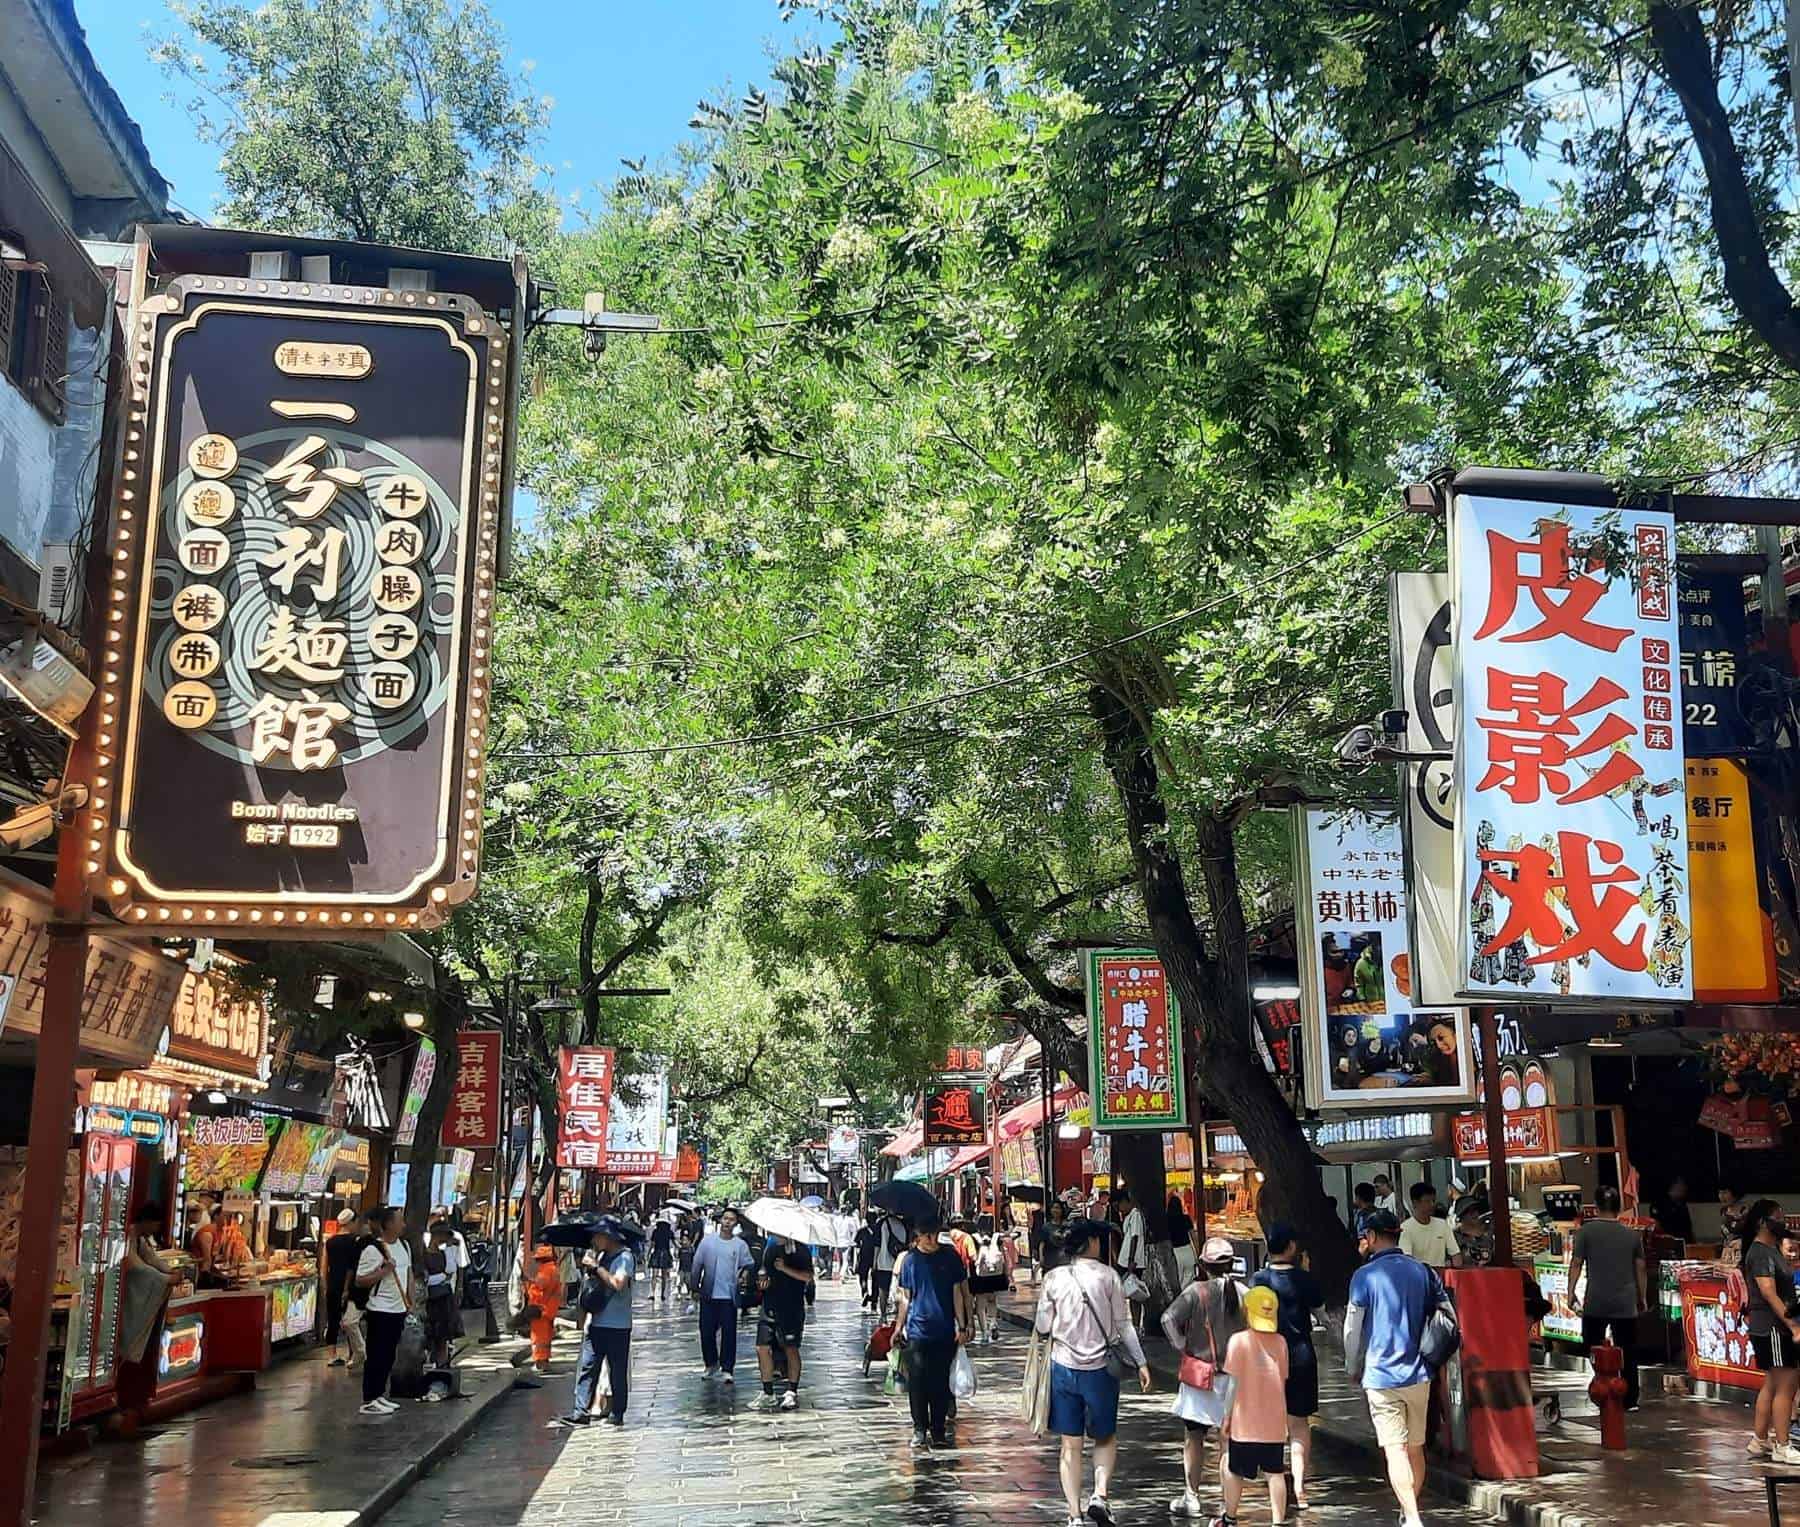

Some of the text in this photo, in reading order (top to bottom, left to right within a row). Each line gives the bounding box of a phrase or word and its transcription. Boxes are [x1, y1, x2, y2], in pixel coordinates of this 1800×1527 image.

[368, 481, 421, 702] 牛肉臊子面
[171, 592, 219, 719] 裤带面
[1646, 642, 1670, 746] 文化传承
[1472, 517, 1650, 972] 皮影戏
[245, 824, 336, 845] 始于 1992
[282, 804, 356, 821] Noodles
[1691, 796, 1733, 818] 餐厅
[1316, 890, 1407, 923] 黄桂柿
[1649, 814, 1686, 990] 喝茶看表演
[193, 1116, 266, 1145] 铁板鱿鱼
[455, 1041, 488, 1139] 吉祥客栈
[561, 1053, 607, 1166] 居佳民宿
